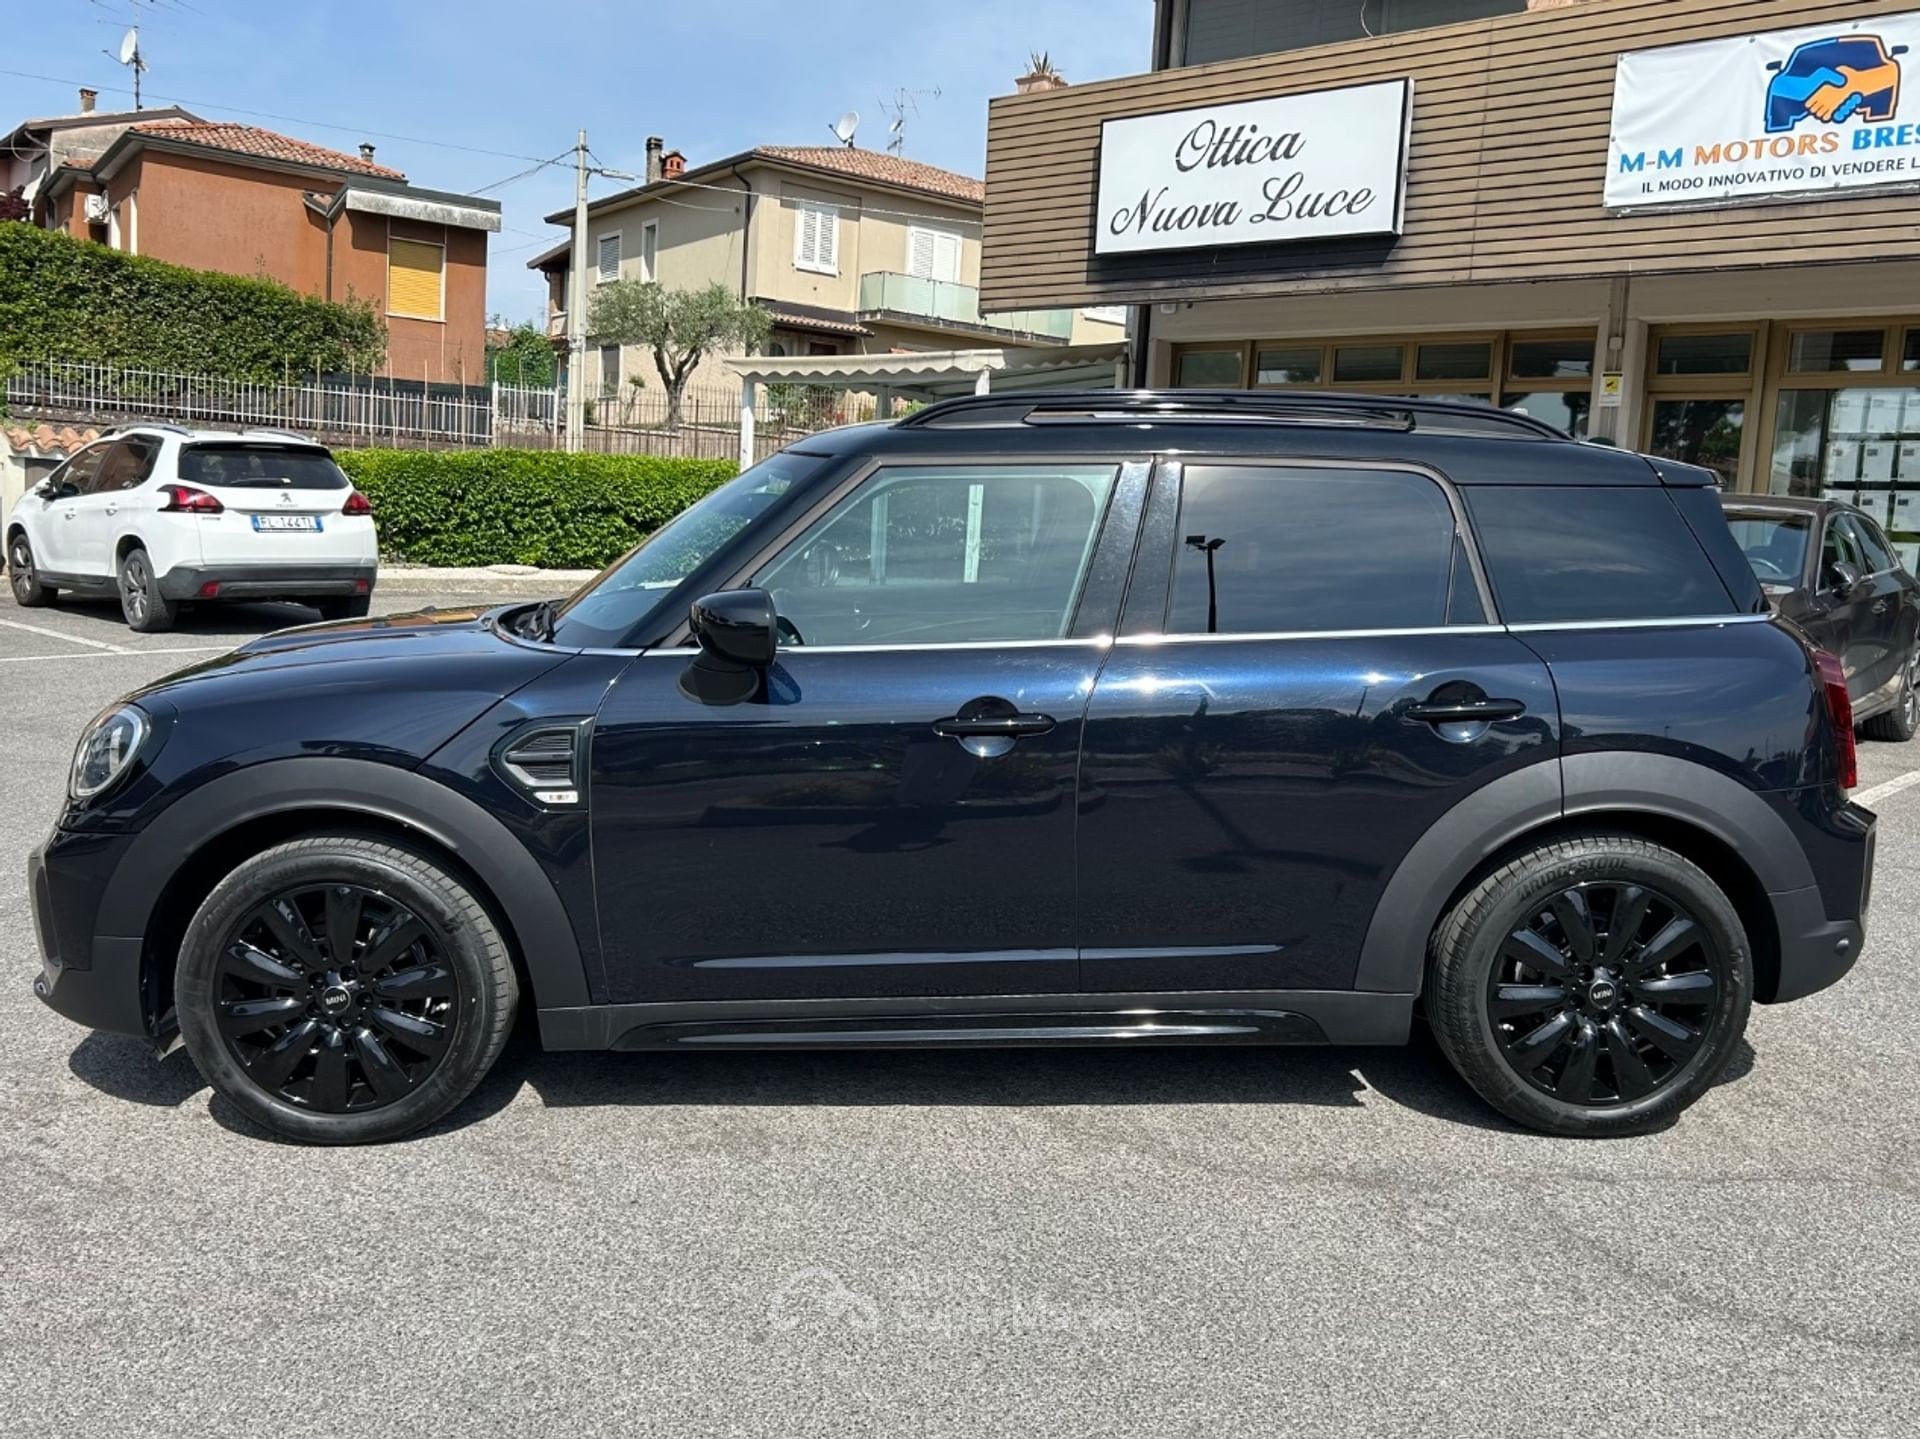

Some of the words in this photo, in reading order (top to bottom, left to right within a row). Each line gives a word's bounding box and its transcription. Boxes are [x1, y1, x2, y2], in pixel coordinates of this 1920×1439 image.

[1175, 119, 1306, 172] Ottica
[1619, 147, 1683, 173] M-M
[1694, 132, 1839, 165] MOTORS
[1641, 181, 1653, 193] IL
[1658, 177, 1704, 192] MODO
[1708, 167, 1804, 187] INNOVATIVO
[1809, 165, 1826, 177] DI
[1832, 158, 1906, 175] VENDERE
[1110, 186, 1243, 235] Nuova
[1249, 171, 1376, 224] Luce
